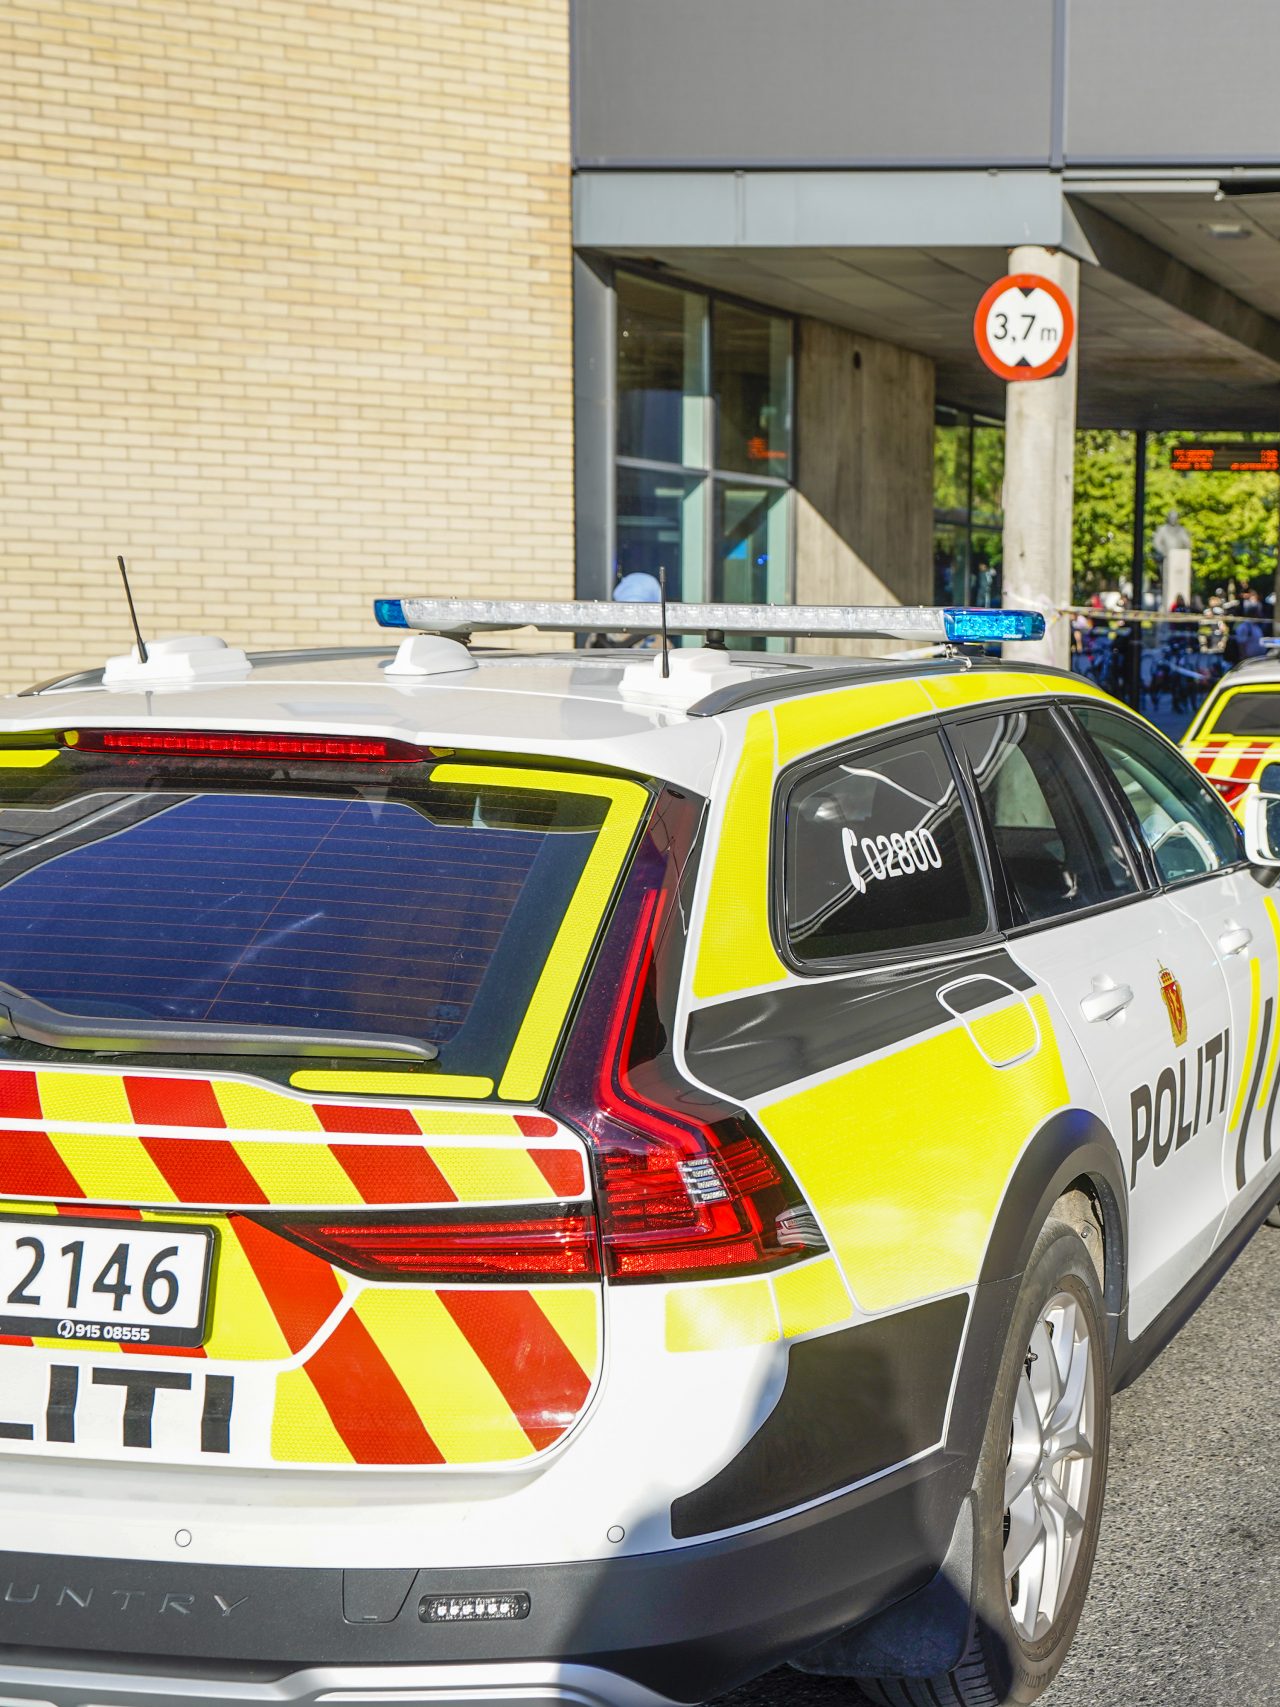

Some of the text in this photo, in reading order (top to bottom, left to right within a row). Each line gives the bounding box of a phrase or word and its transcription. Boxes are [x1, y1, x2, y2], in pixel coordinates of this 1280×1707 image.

[994, 313, 1057, 342] 3,7 m
[861, 828, 942, 880] 02800
[1130, 1027, 1230, 1192] POLITI
[7, 1236, 180, 1315] 2146
[75, 1323, 150, 1341] 915 08555
